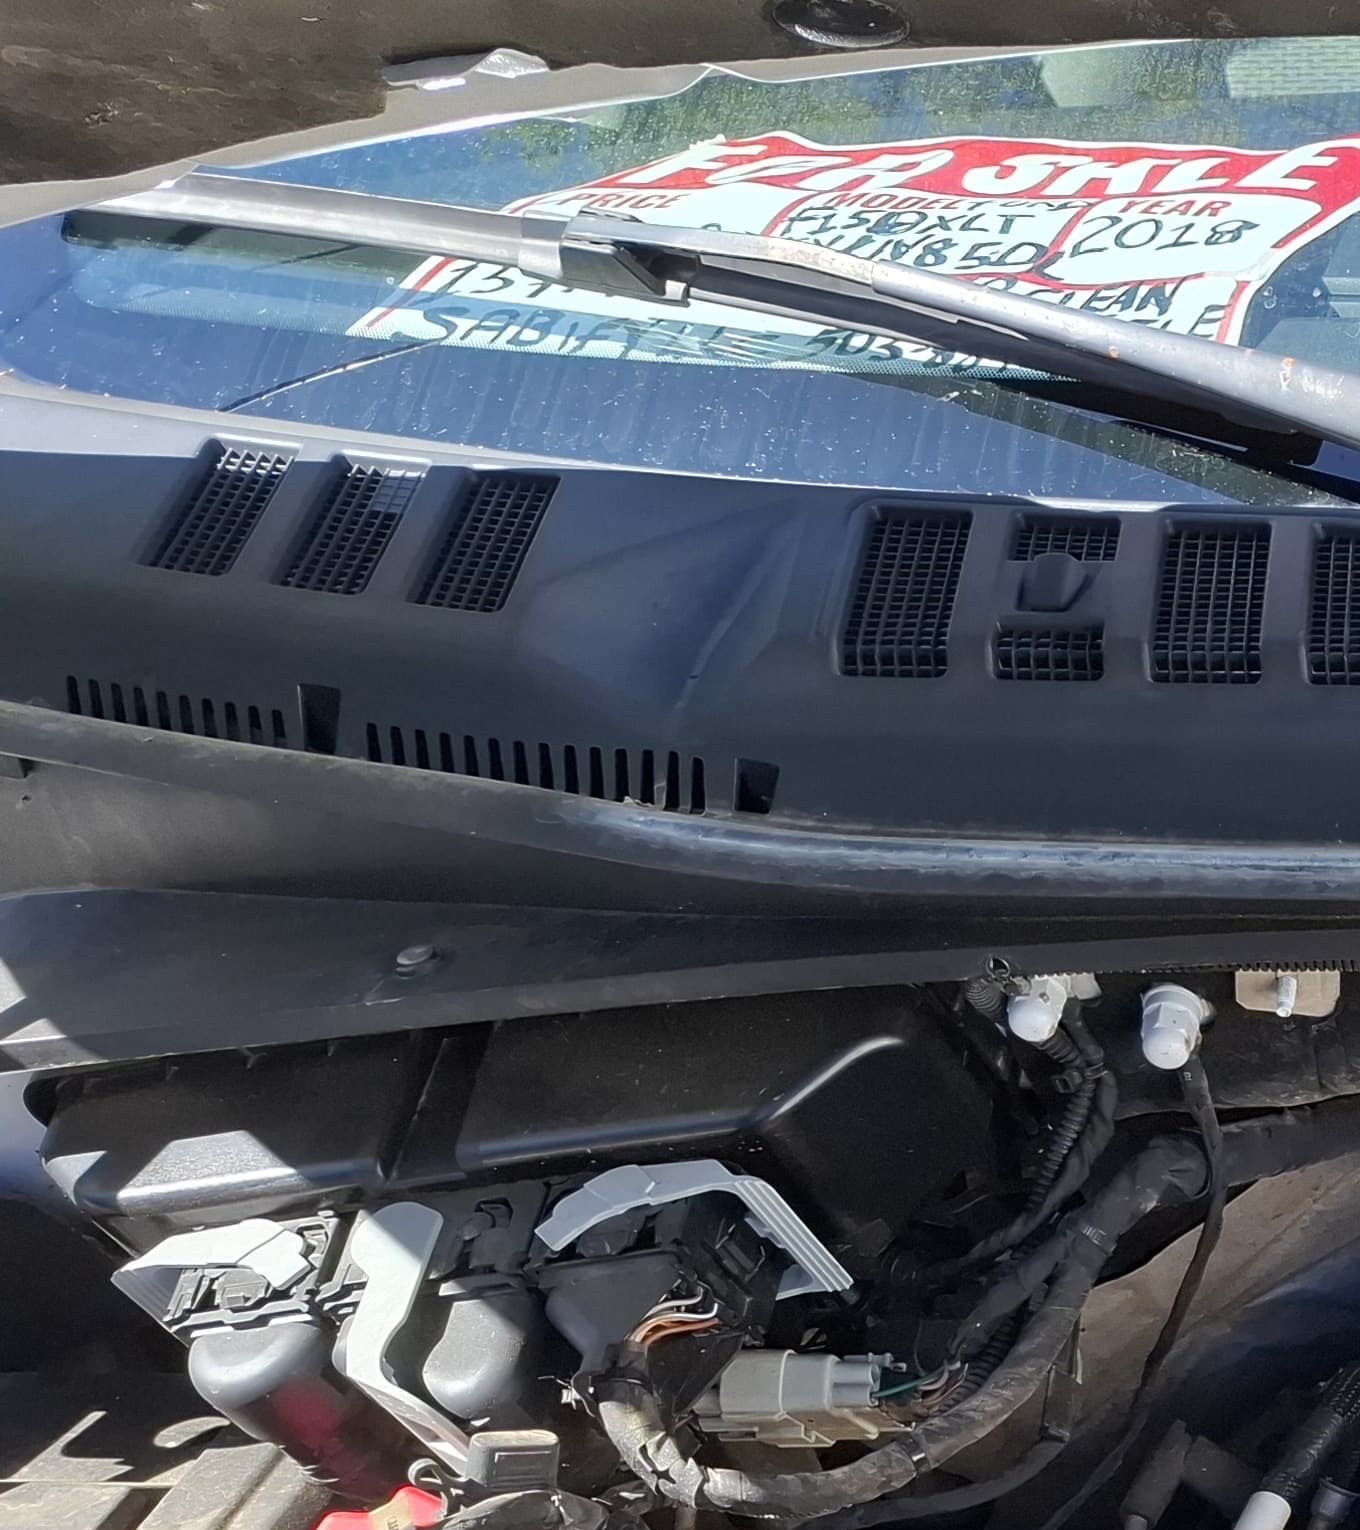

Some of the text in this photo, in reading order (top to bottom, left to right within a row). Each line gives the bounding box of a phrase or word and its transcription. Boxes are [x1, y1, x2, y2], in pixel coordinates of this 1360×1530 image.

[617, 140, 1340, 195] FOR SALE
[557, 192, 692, 210] PRICE
[822, 192, 967, 210] MODEL
[1118, 200, 1232, 216] YEAR
[915, 212, 1037, 235] XLT
[1069, 215, 1260, 258] 2018
